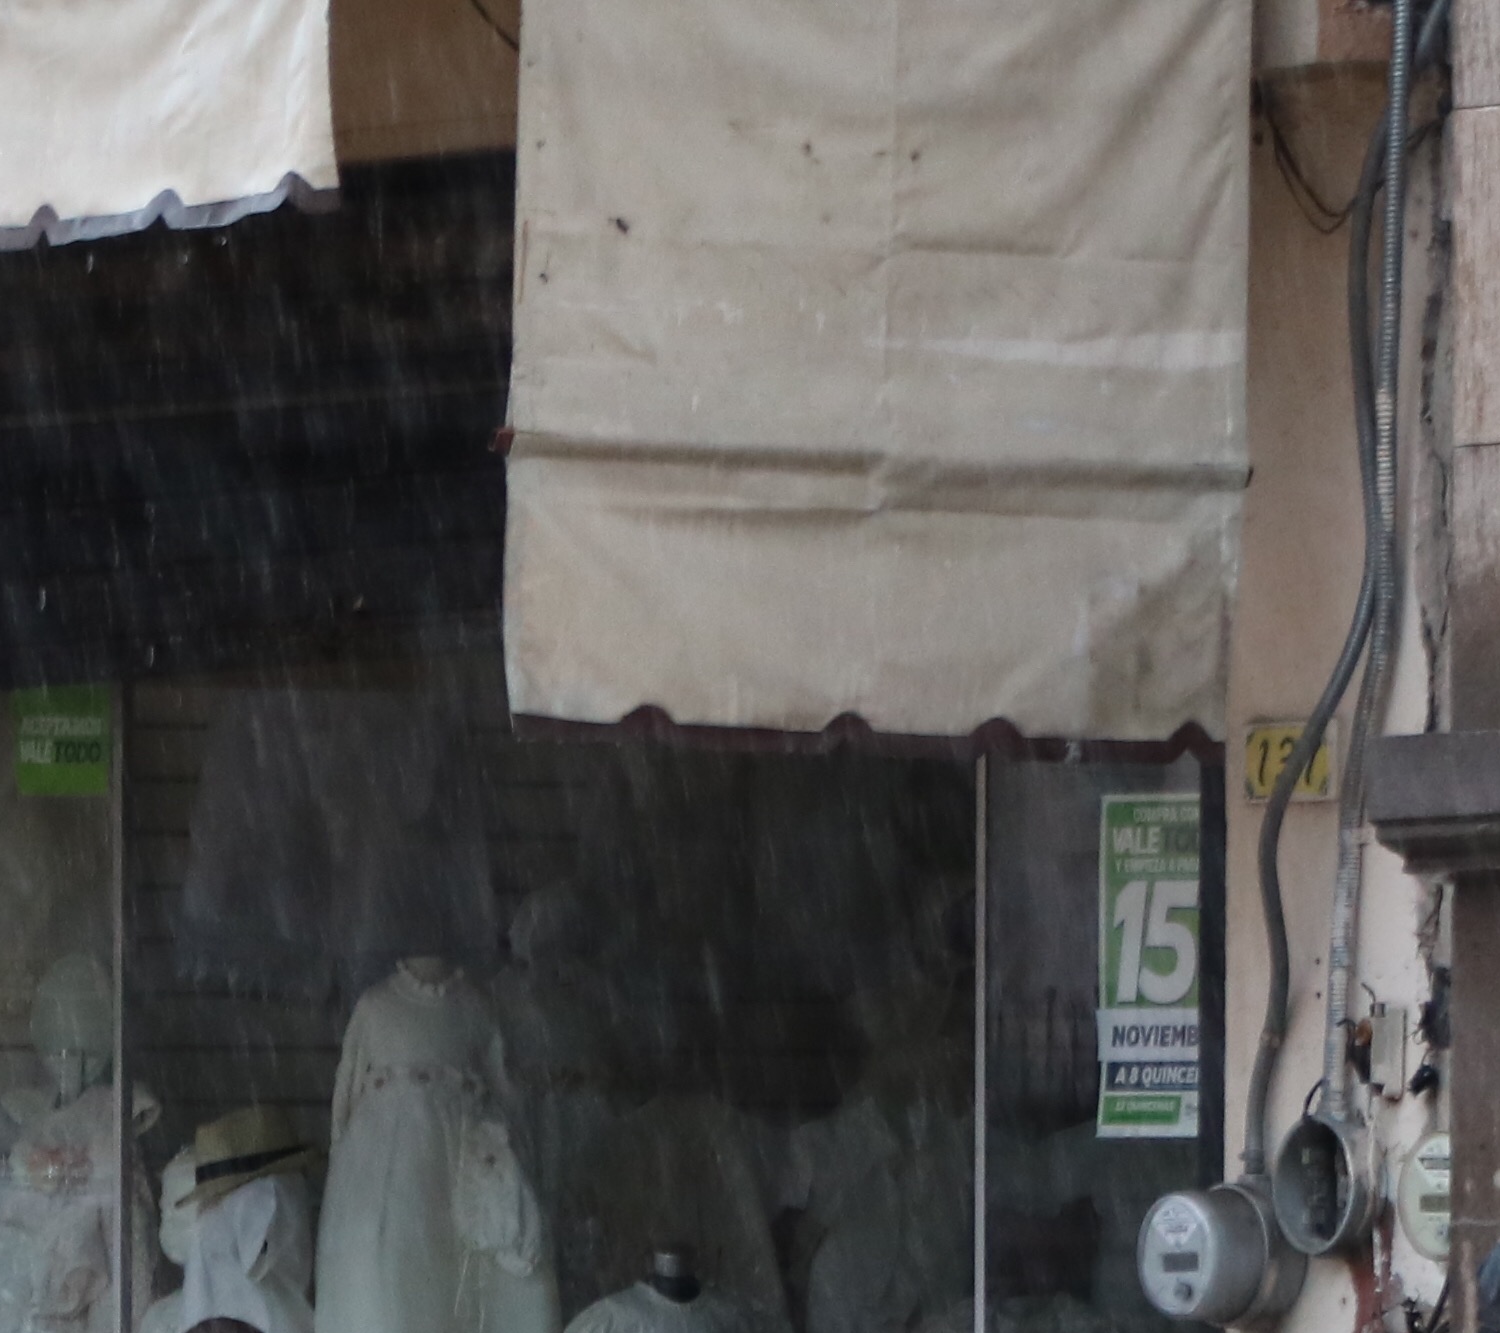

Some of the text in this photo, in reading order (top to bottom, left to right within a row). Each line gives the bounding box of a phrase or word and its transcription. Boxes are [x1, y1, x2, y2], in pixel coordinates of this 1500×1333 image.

[1113, 880, 1200, 1004] 15
[1114, 1066, 1126, 1085] A
[1128, 1066, 1140, 1085] 8
